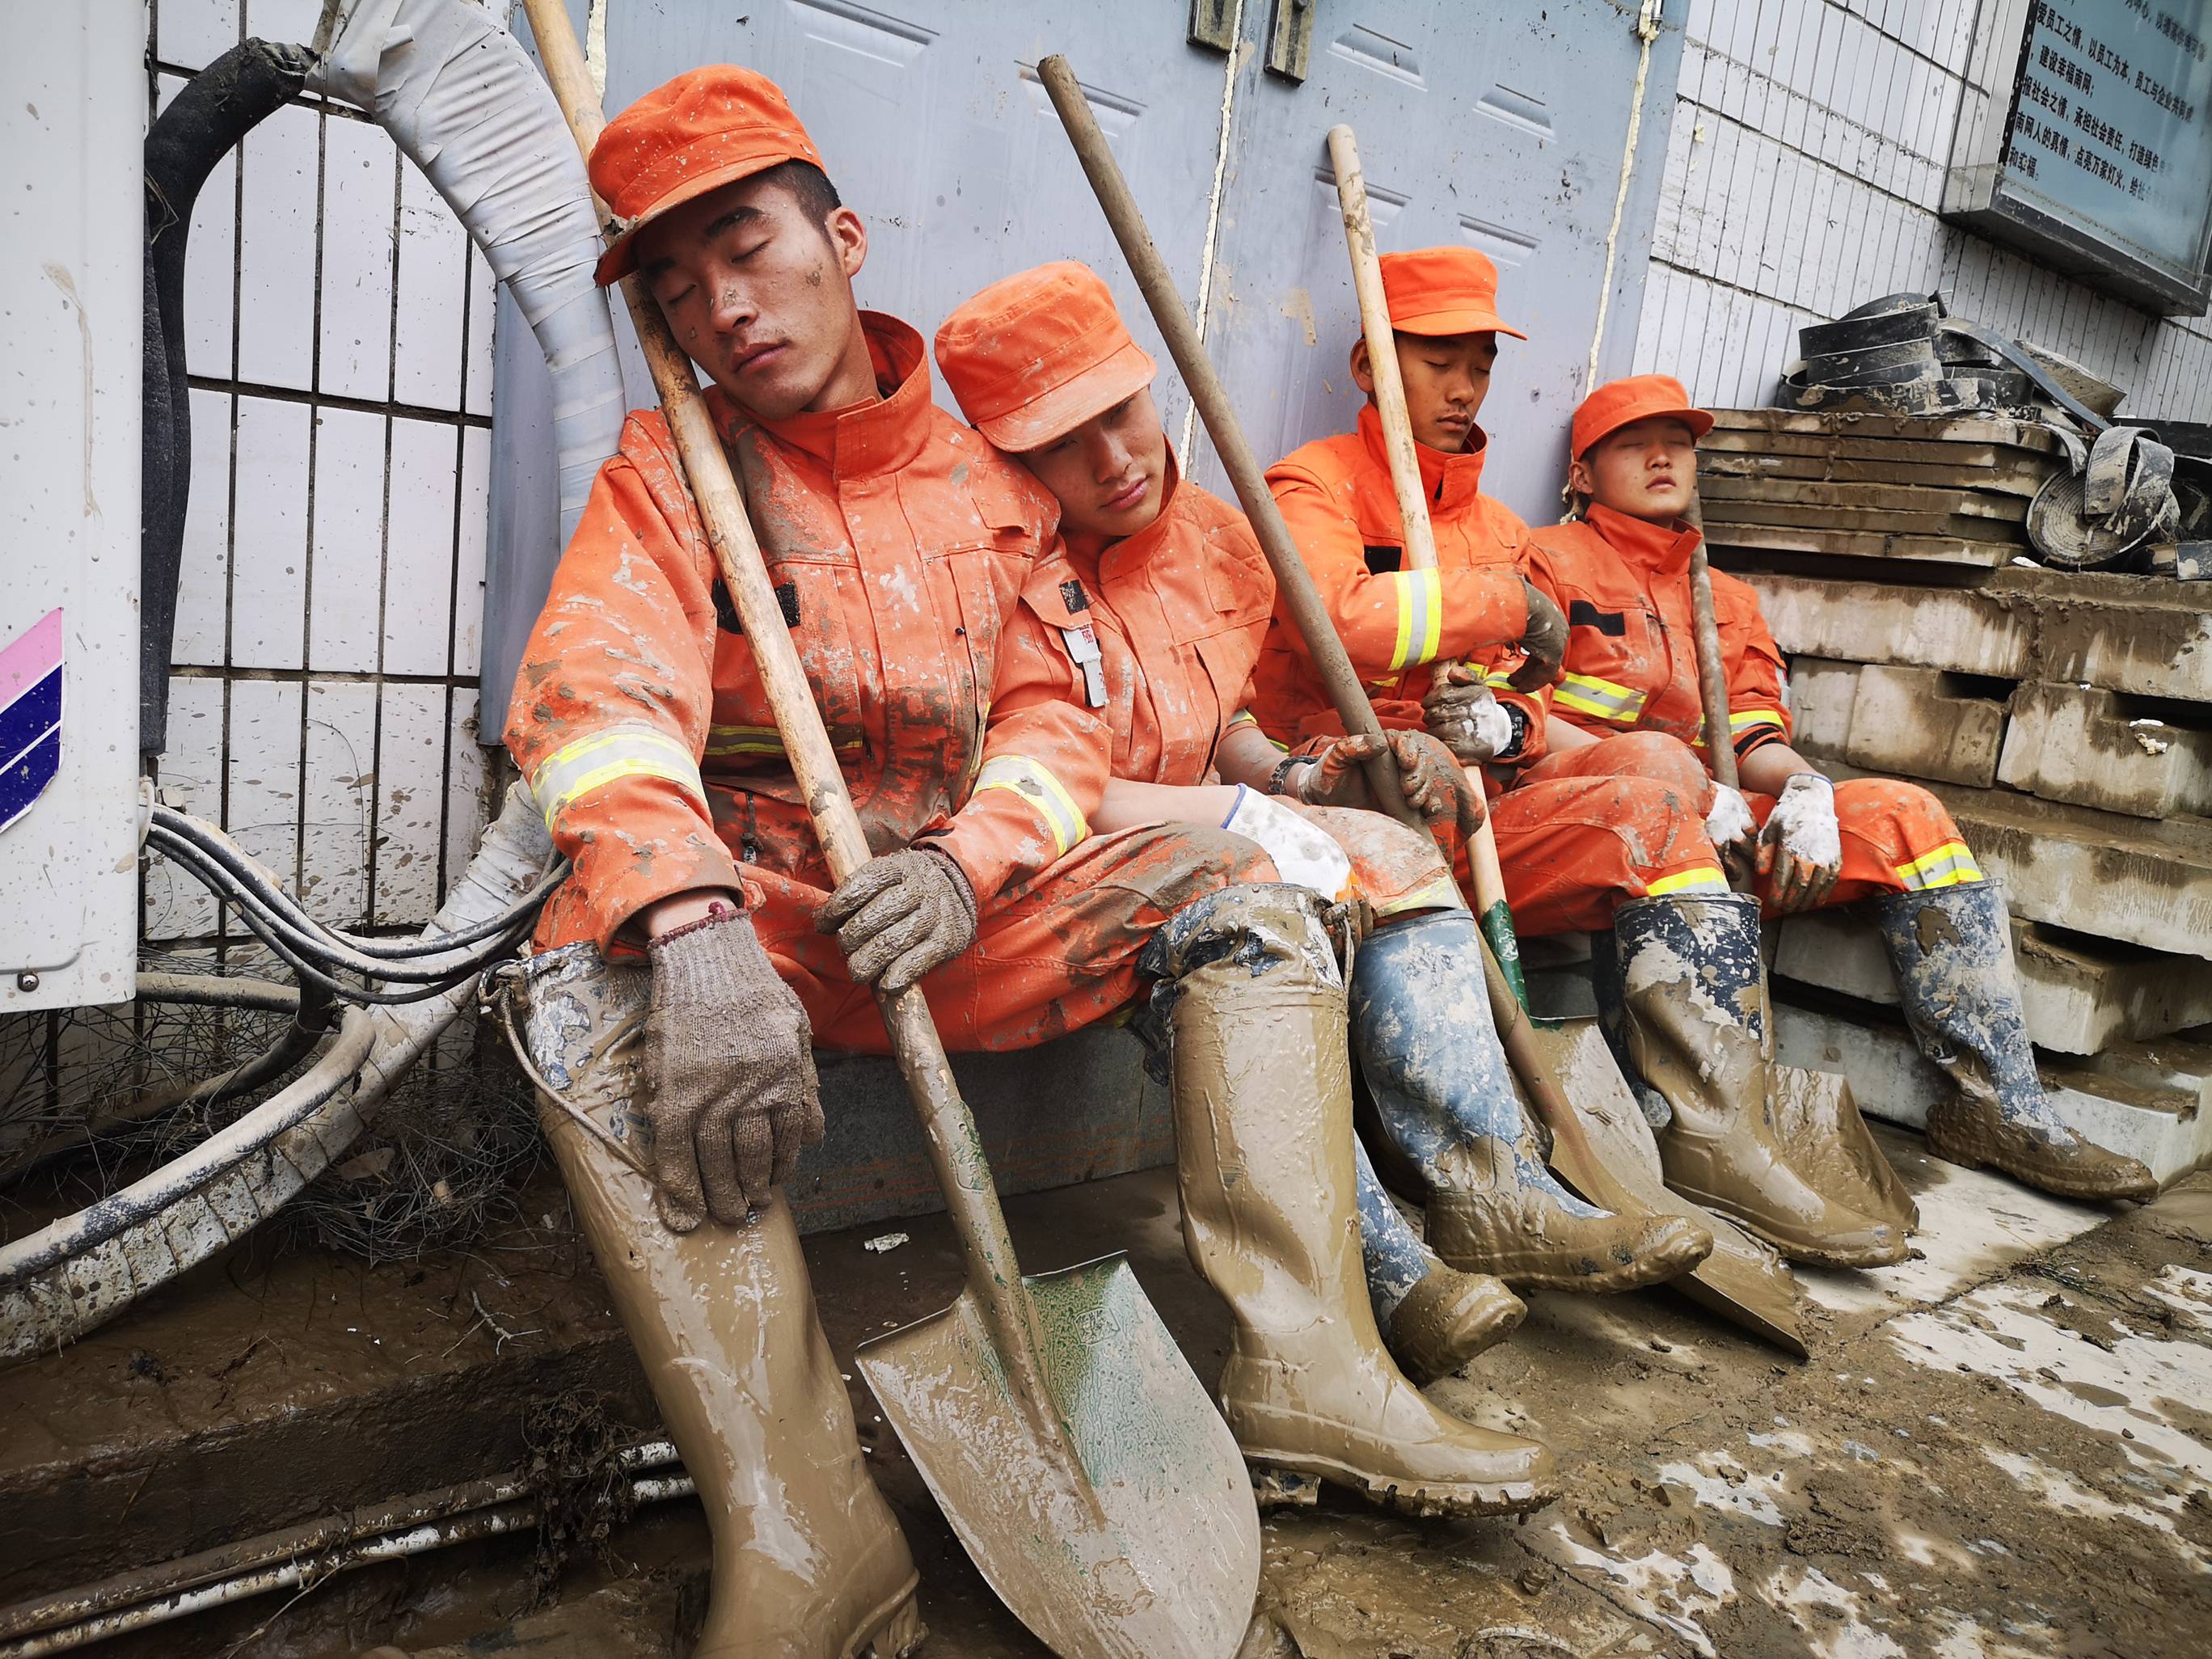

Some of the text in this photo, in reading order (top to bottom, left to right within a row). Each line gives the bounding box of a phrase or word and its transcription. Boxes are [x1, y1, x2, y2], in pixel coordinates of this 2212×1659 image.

[2022, 74, 2173, 178] 报社会之情，承担社会责任，打造绿色
